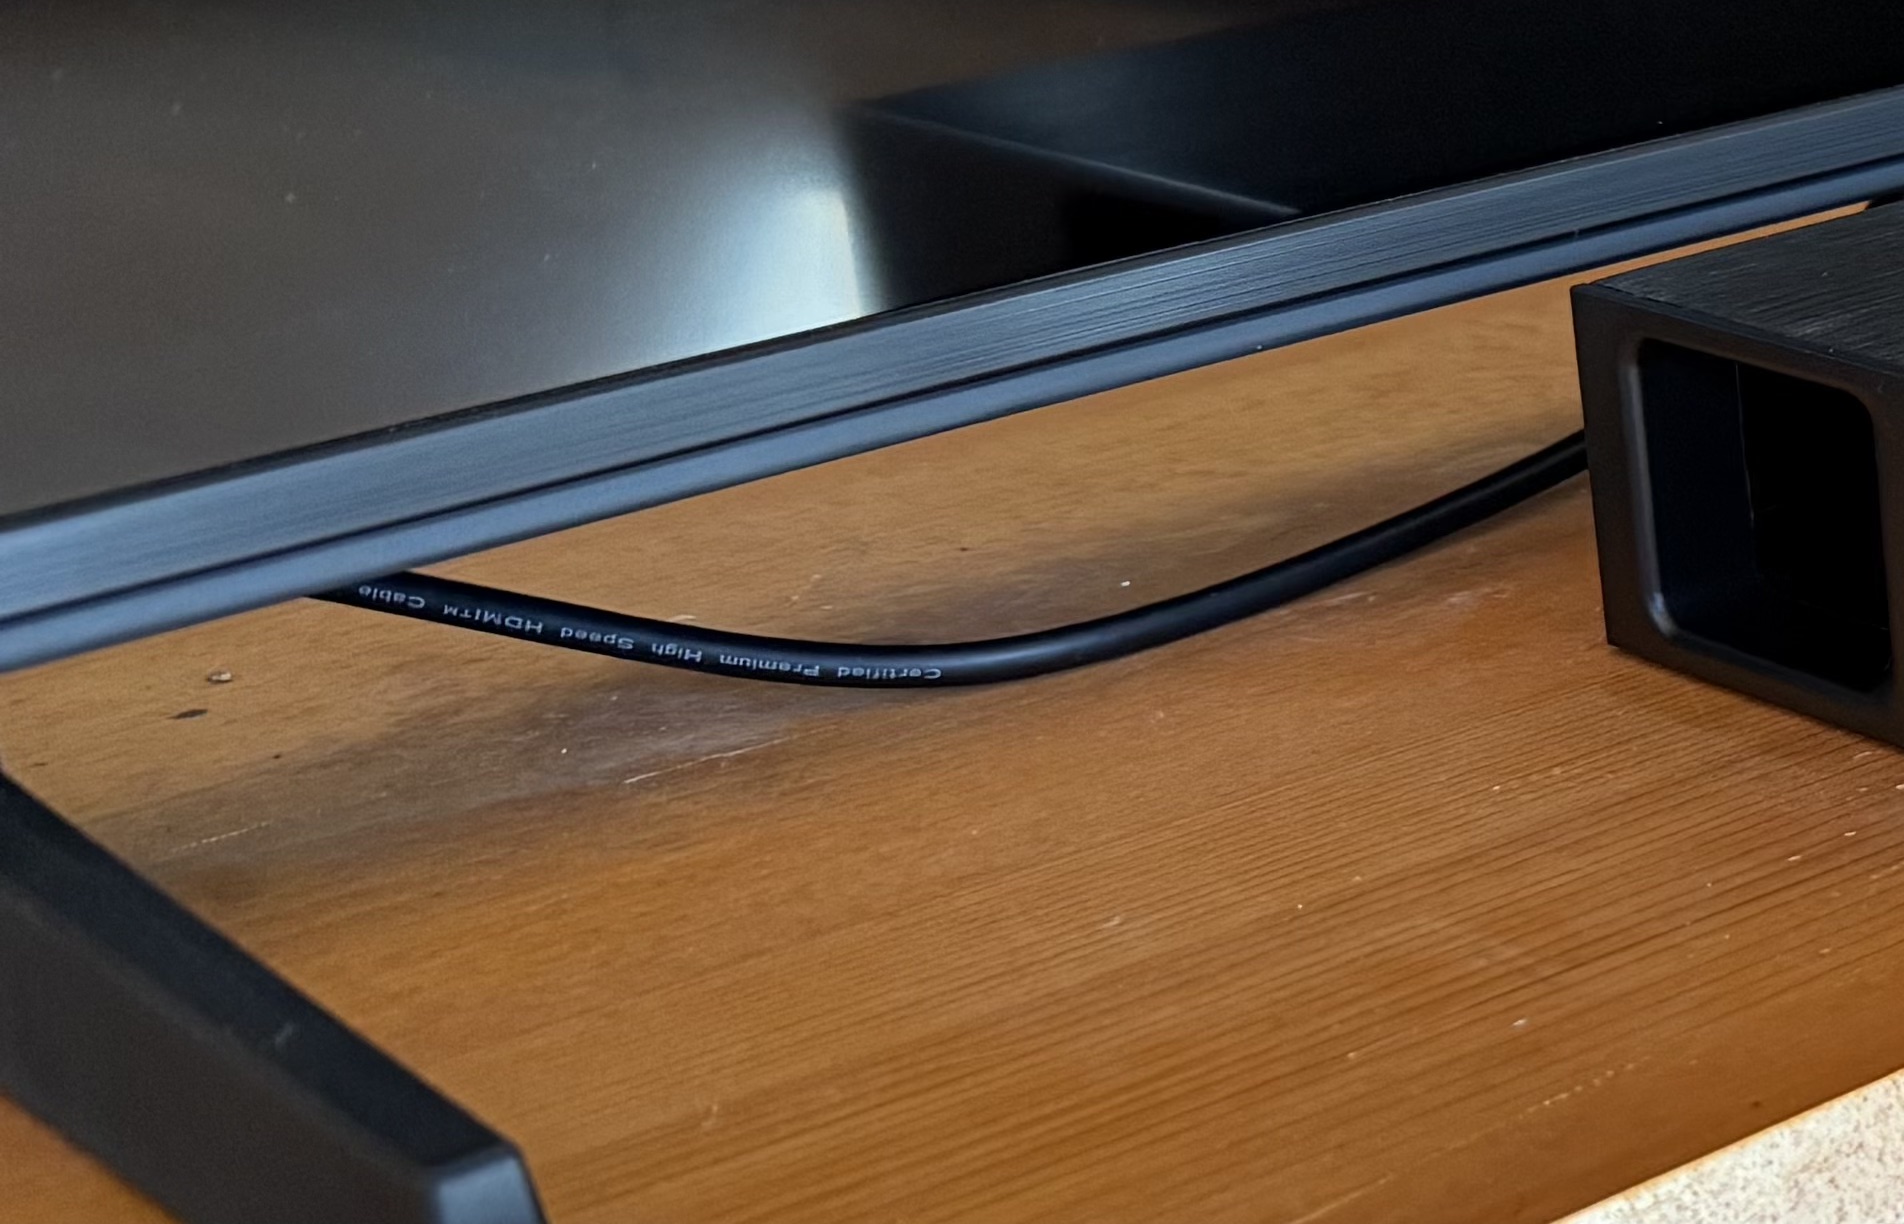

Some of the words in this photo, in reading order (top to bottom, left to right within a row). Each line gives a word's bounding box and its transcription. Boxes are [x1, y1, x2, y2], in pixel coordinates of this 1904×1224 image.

[357, 584, 426, 610] Cable
[559, 625, 635, 651] Speed
[650, 641, 703, 663] High
[718, 652, 821, 677] Premium
[837, 665, 943, 680] Certified
